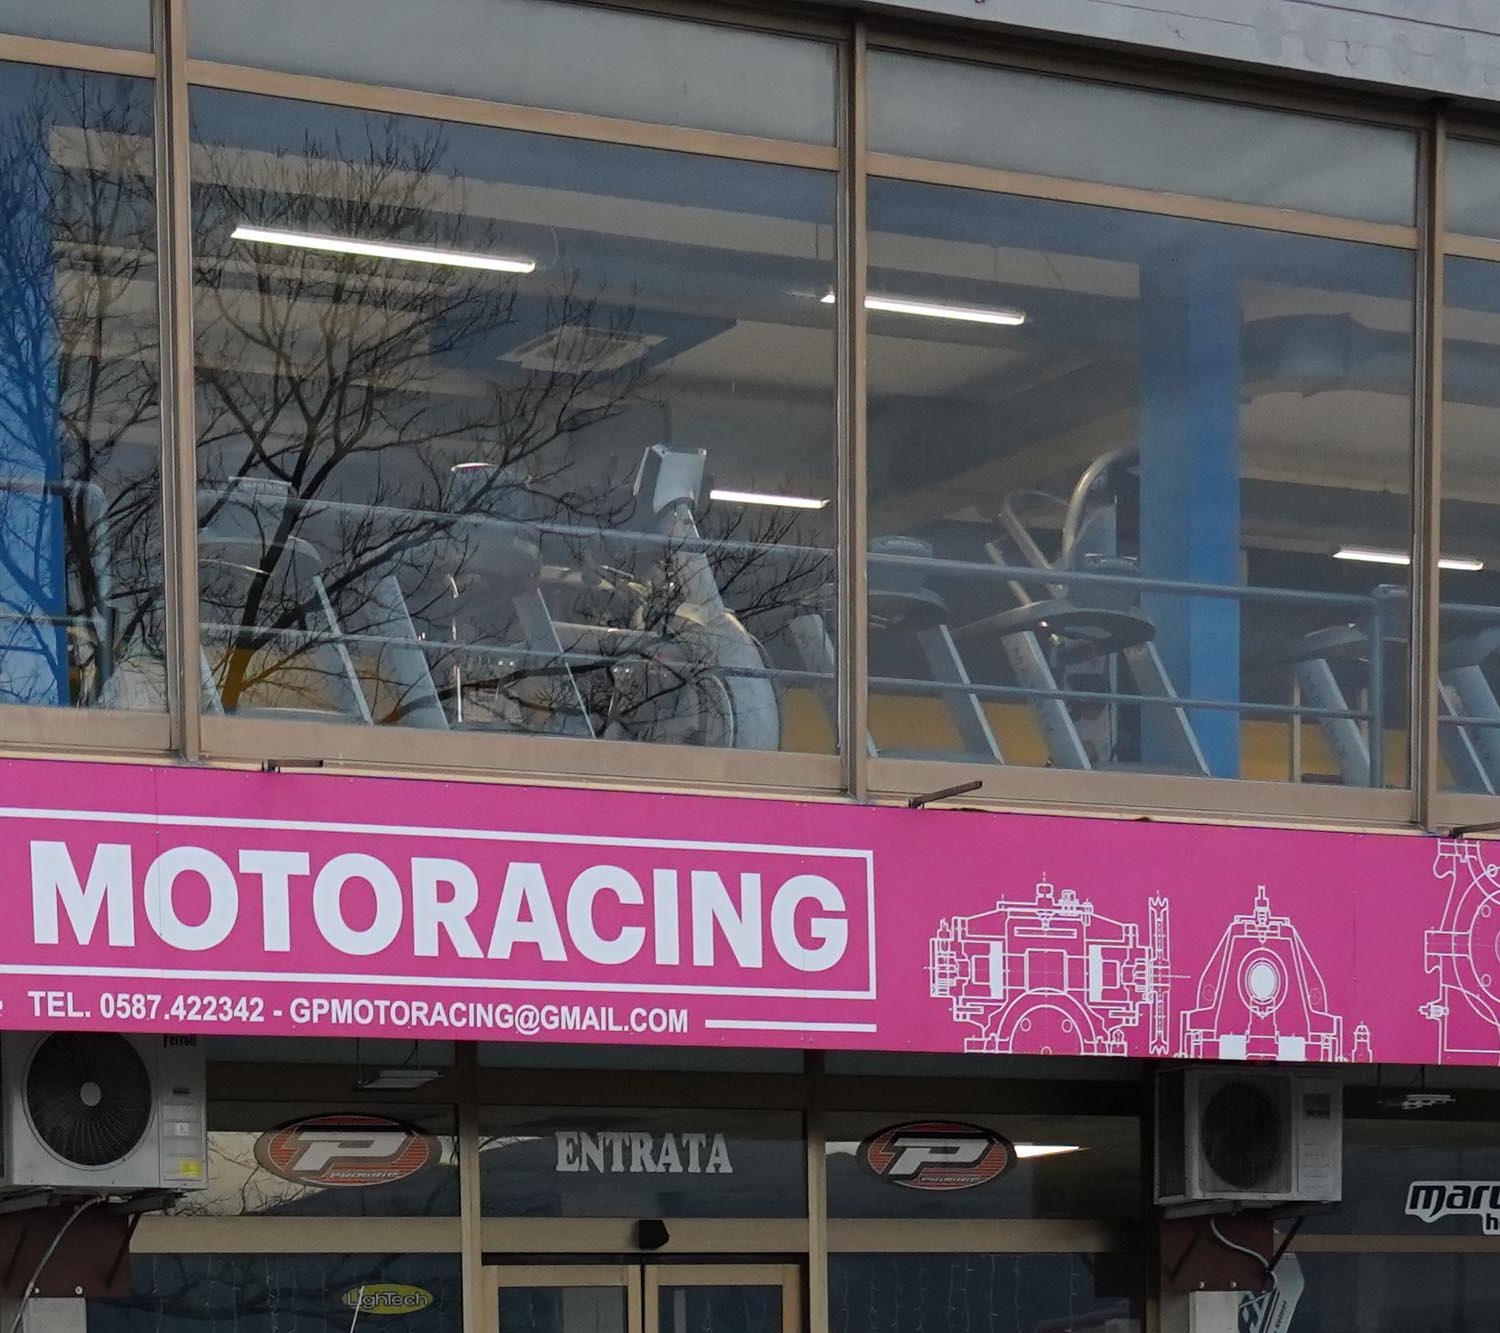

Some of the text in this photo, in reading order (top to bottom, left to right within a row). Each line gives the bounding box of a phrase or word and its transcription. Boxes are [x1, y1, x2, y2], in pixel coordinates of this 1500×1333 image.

[30, 840, 849, 972] MOTORACING
[28, 991, 91, 1018] TEL.
[99, 992, 265, 1022] 0587.422342
[289, 998, 689, 1036] GPMOTORACING@GMAIL.COM
[555, 1131, 733, 1174] ENTRATA
